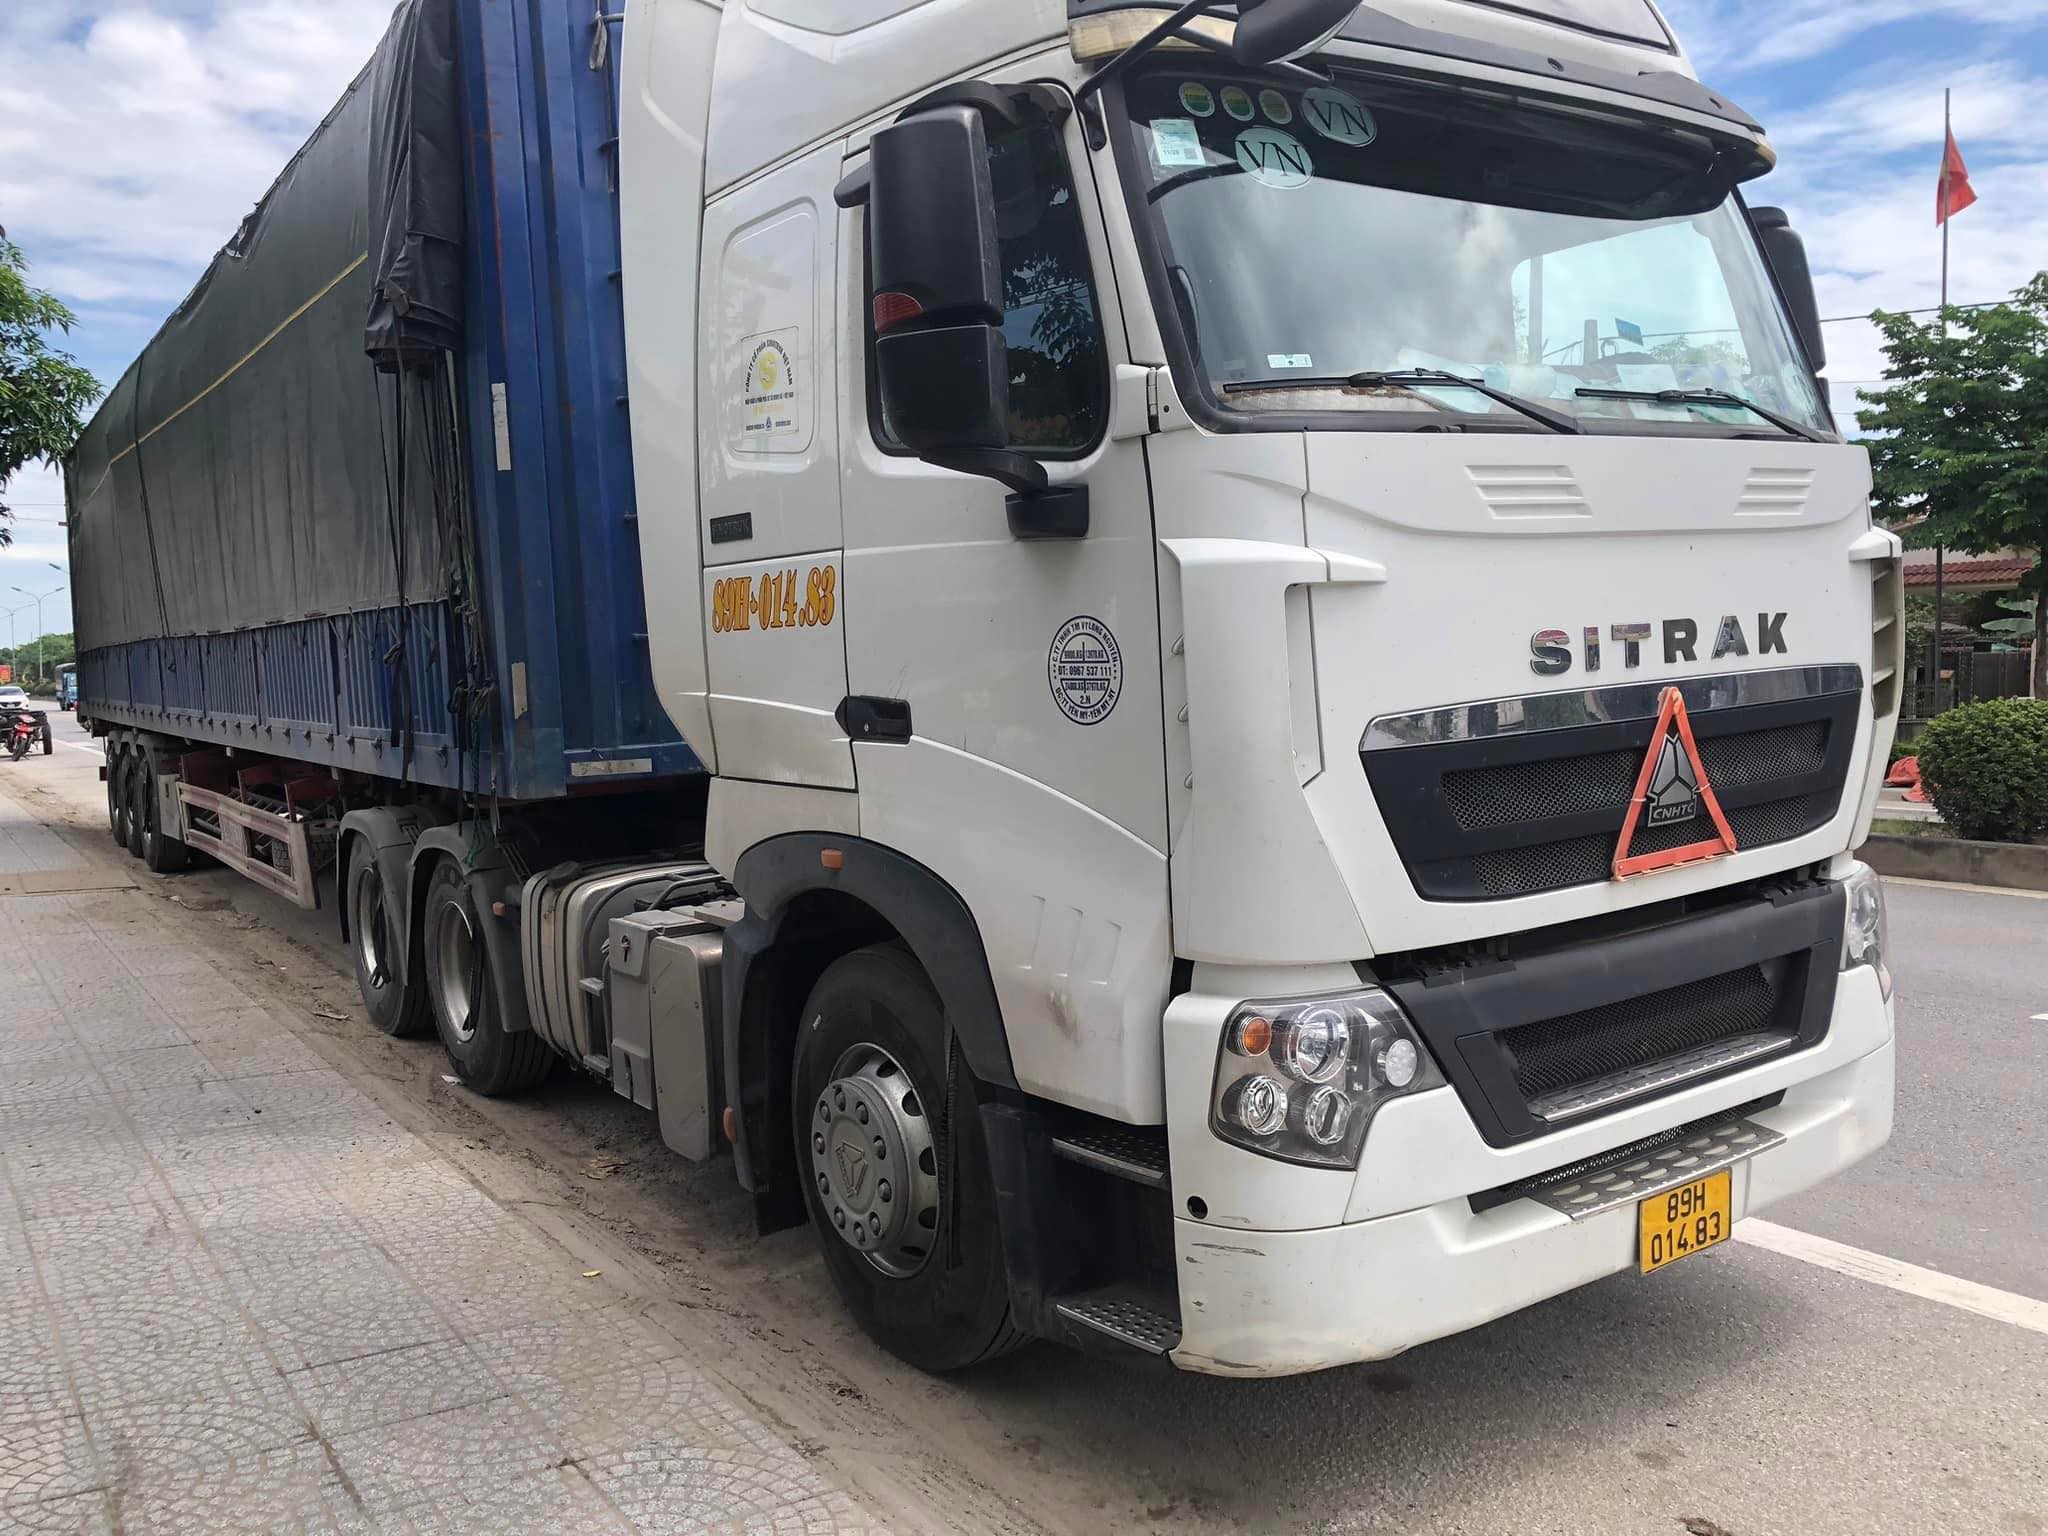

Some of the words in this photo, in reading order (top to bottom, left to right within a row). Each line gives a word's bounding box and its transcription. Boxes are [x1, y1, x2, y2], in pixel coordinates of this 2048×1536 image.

[1302, 97, 1370, 138] VN
[1235, 139, 1308, 177] VN
[1530, 612, 1788, 676] SITRAK
[1086, 666, 1098, 677] 537
[1100, 666, 1112, 677] 111
[1653, 802, 1694, 819] CNHTC
[1667, 1182, 1706, 1223] 89H
[1651, 1211, 1721, 1265] 014.83
